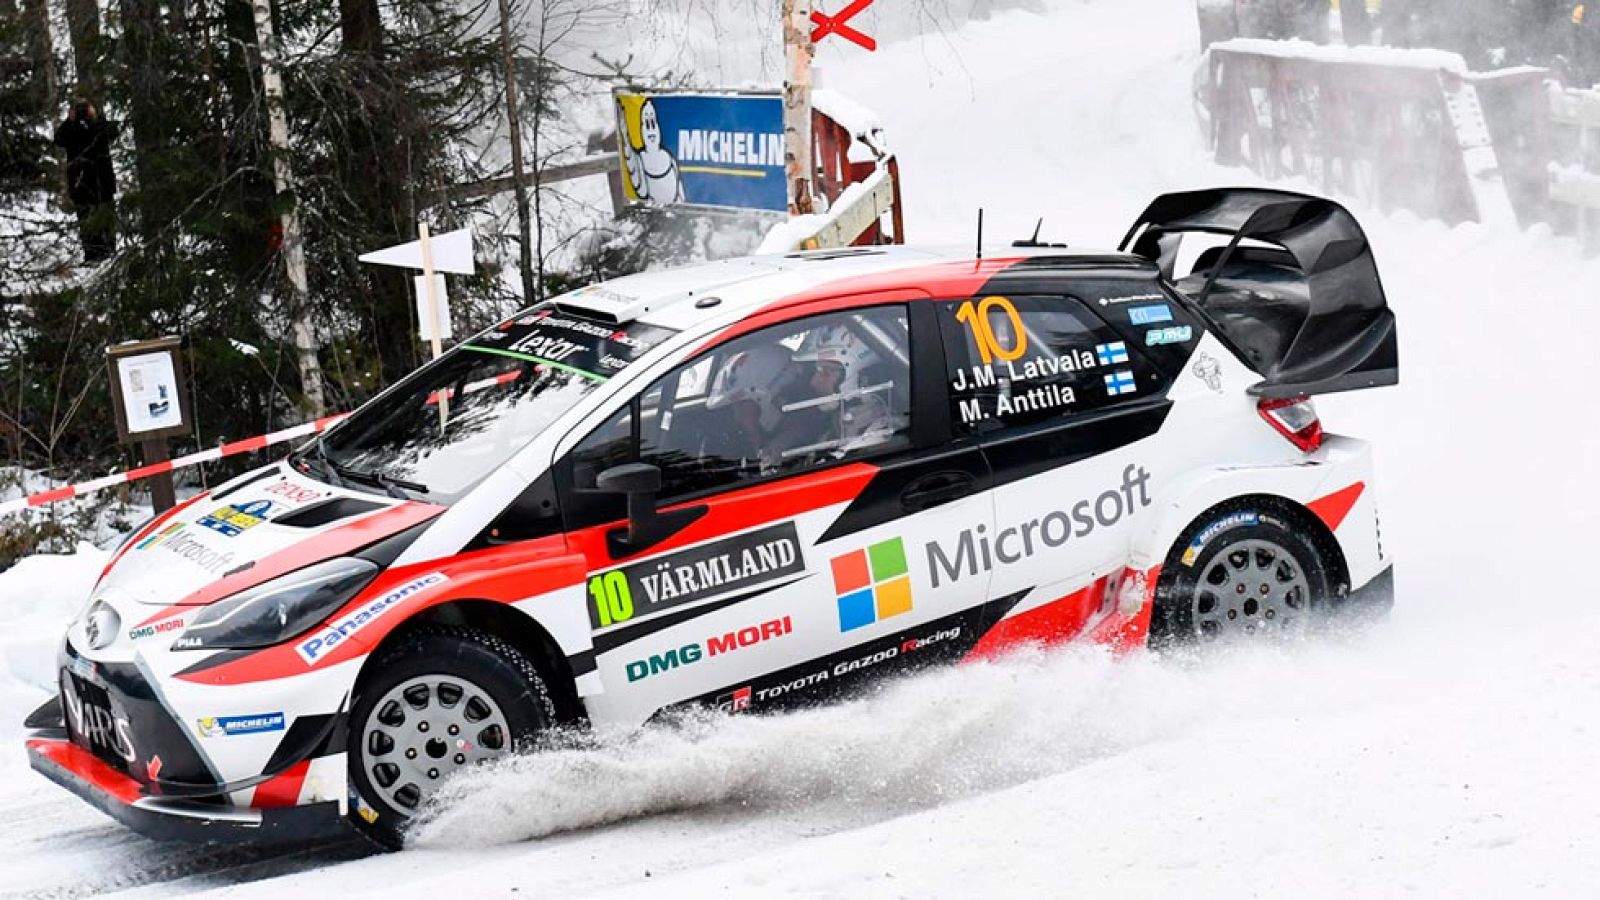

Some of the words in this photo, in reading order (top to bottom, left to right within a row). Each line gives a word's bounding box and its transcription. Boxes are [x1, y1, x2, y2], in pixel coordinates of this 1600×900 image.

[678, 129, 785, 166] MICHELIN
[955, 296, 1028, 364] 10
[953, 364, 1003, 391] J.M.
[1007, 349, 1096, 382] Latvala
[959, 398, 989, 424] M.
[996, 384, 1076, 417] Anttila
[925, 463, 1152, 589] Microsoft
[589, 569, 634, 626] 10
[640, 537, 797, 603] VÄRMLAND
[302, 576, 440, 659] Panasonic
[626, 643, 701, 682] DMG
[707, 616, 793, 657] MORI
[756, 671, 829, 701] TOYOTA
[901, 625, 961, 654] Racing
